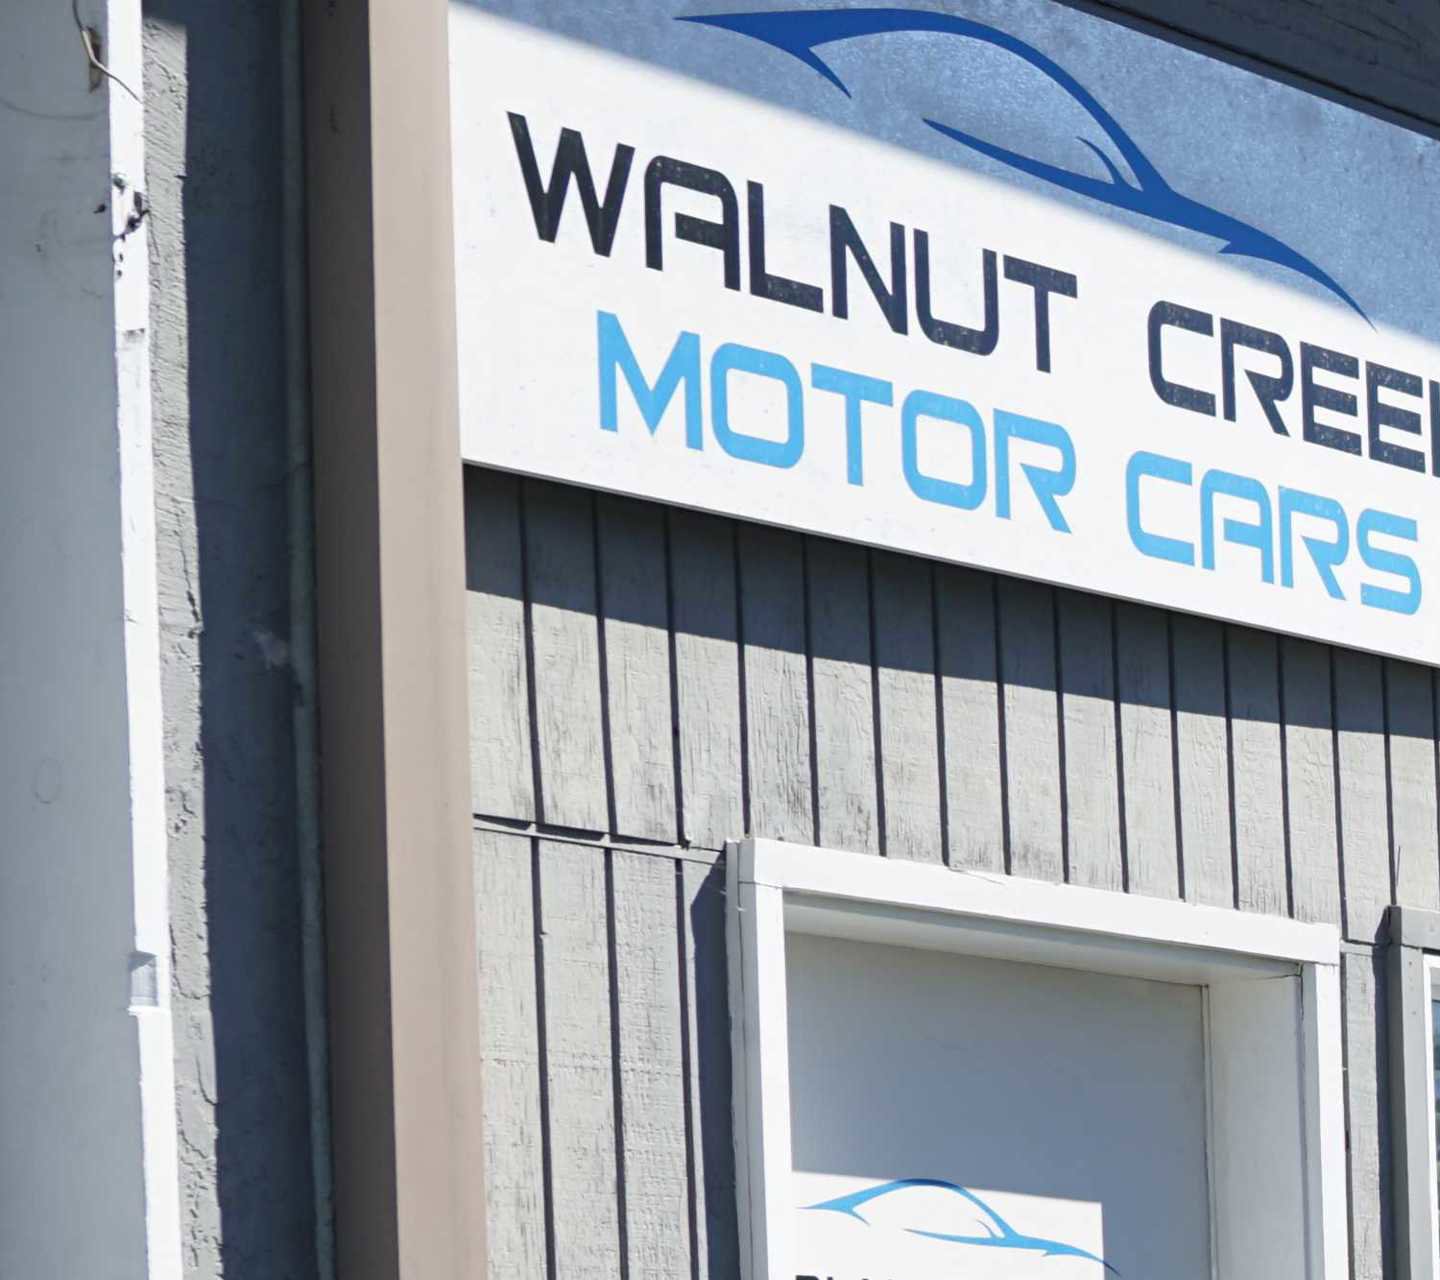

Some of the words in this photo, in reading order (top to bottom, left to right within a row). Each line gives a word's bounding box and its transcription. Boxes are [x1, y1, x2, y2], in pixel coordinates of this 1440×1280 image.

[506, 111, 1078, 374] WALNUT
[596, 309, 1077, 534] MOTOR
[1125, 450, 1423, 617] CARS
